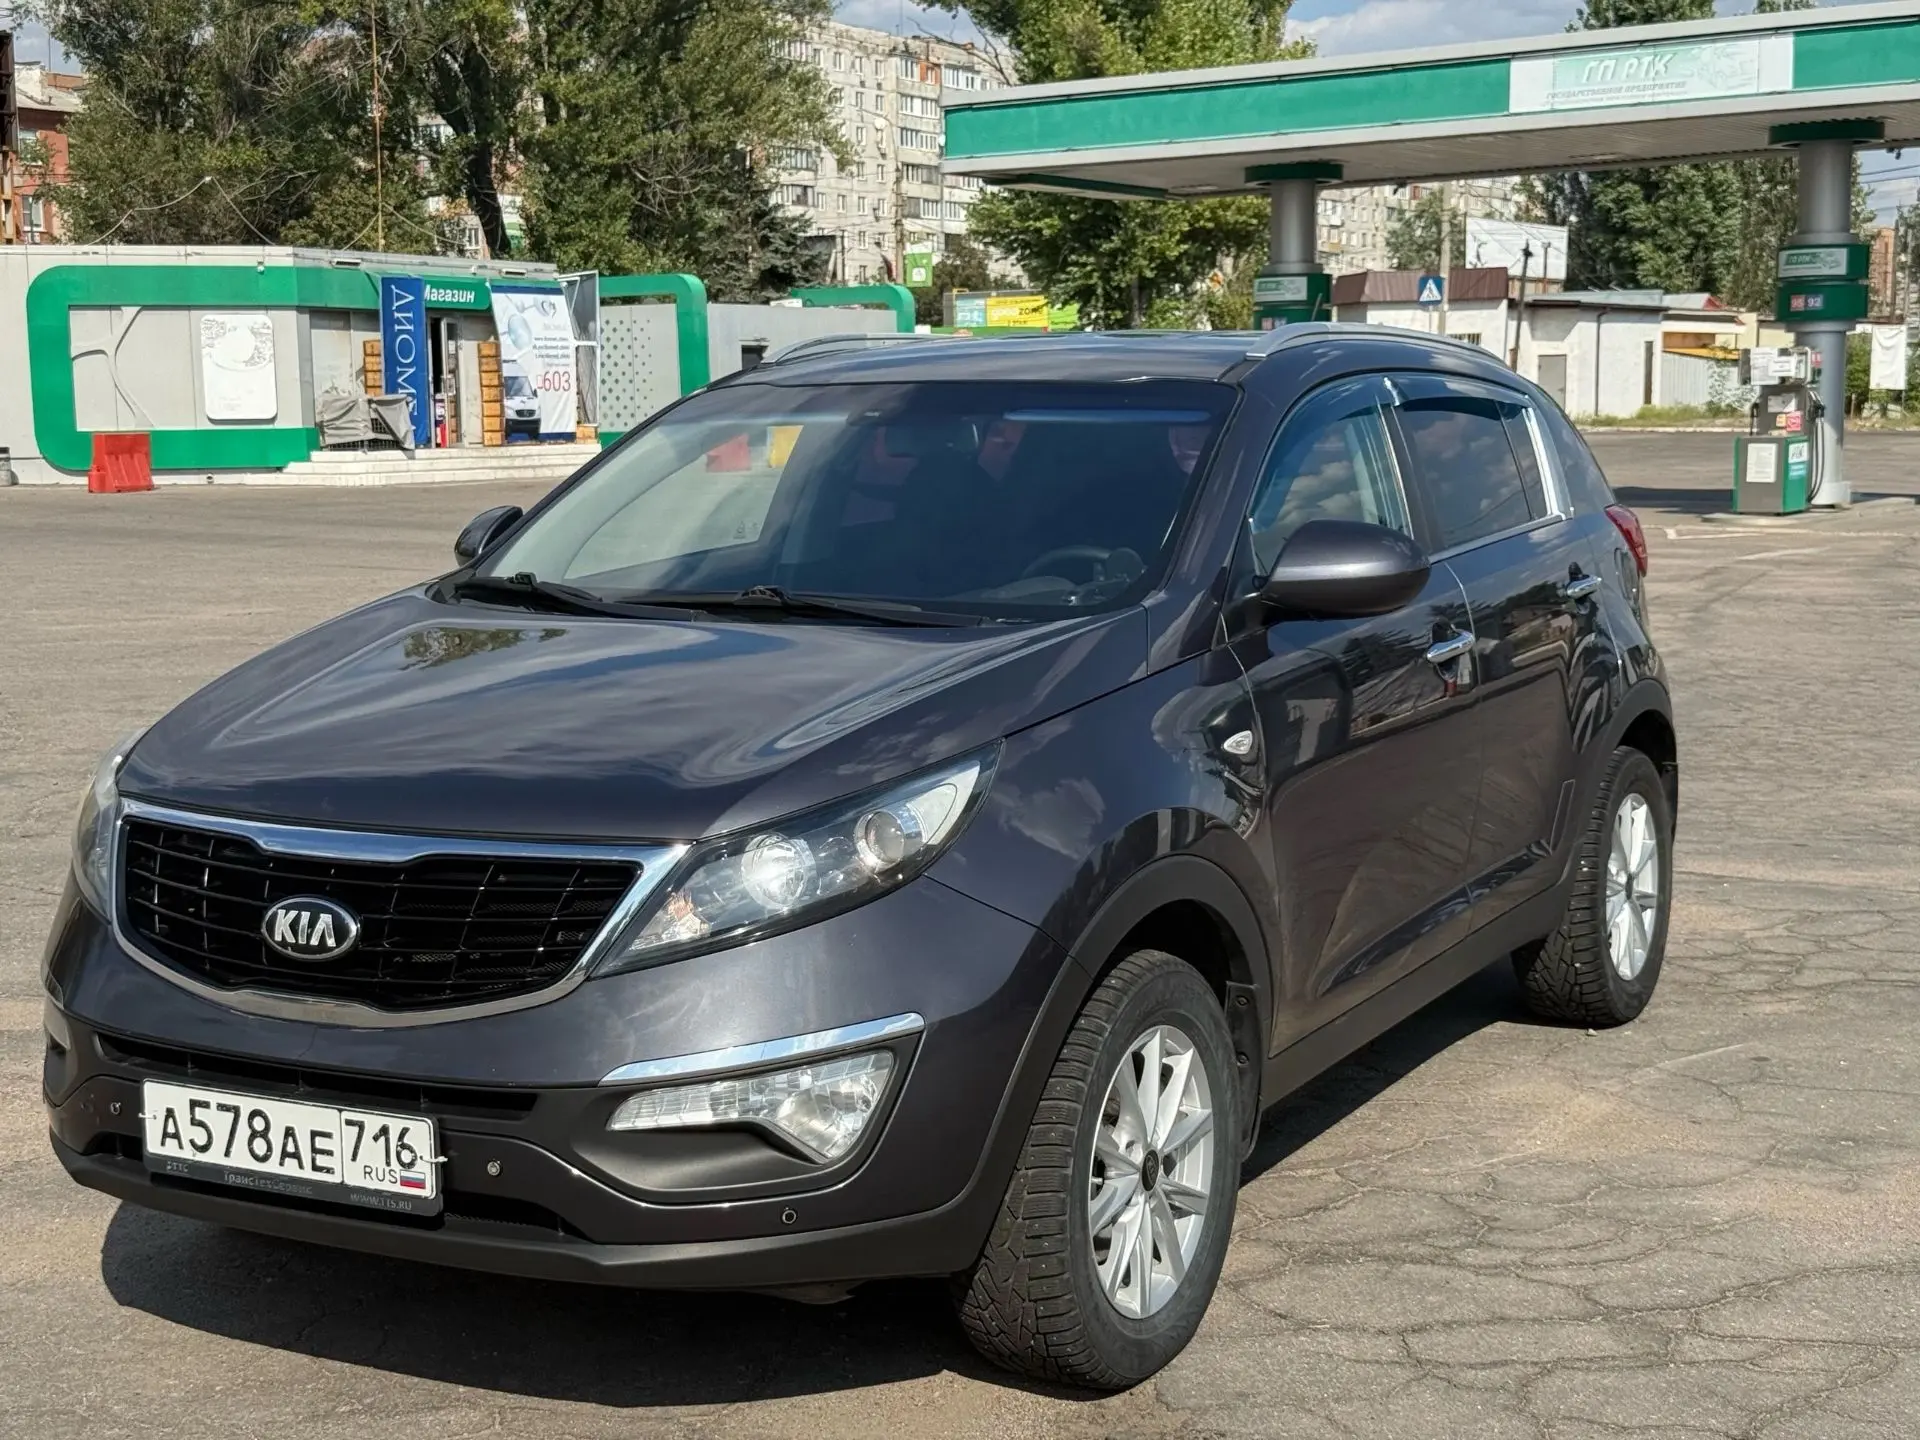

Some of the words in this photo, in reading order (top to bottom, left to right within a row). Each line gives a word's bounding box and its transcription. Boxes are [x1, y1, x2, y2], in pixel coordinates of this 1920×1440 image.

[424, 284, 475, 303] Магазин
[274, 909, 337, 947] KIA
[344, 1118, 418, 1169] 716
[363, 1165, 398, 1184] RUS
